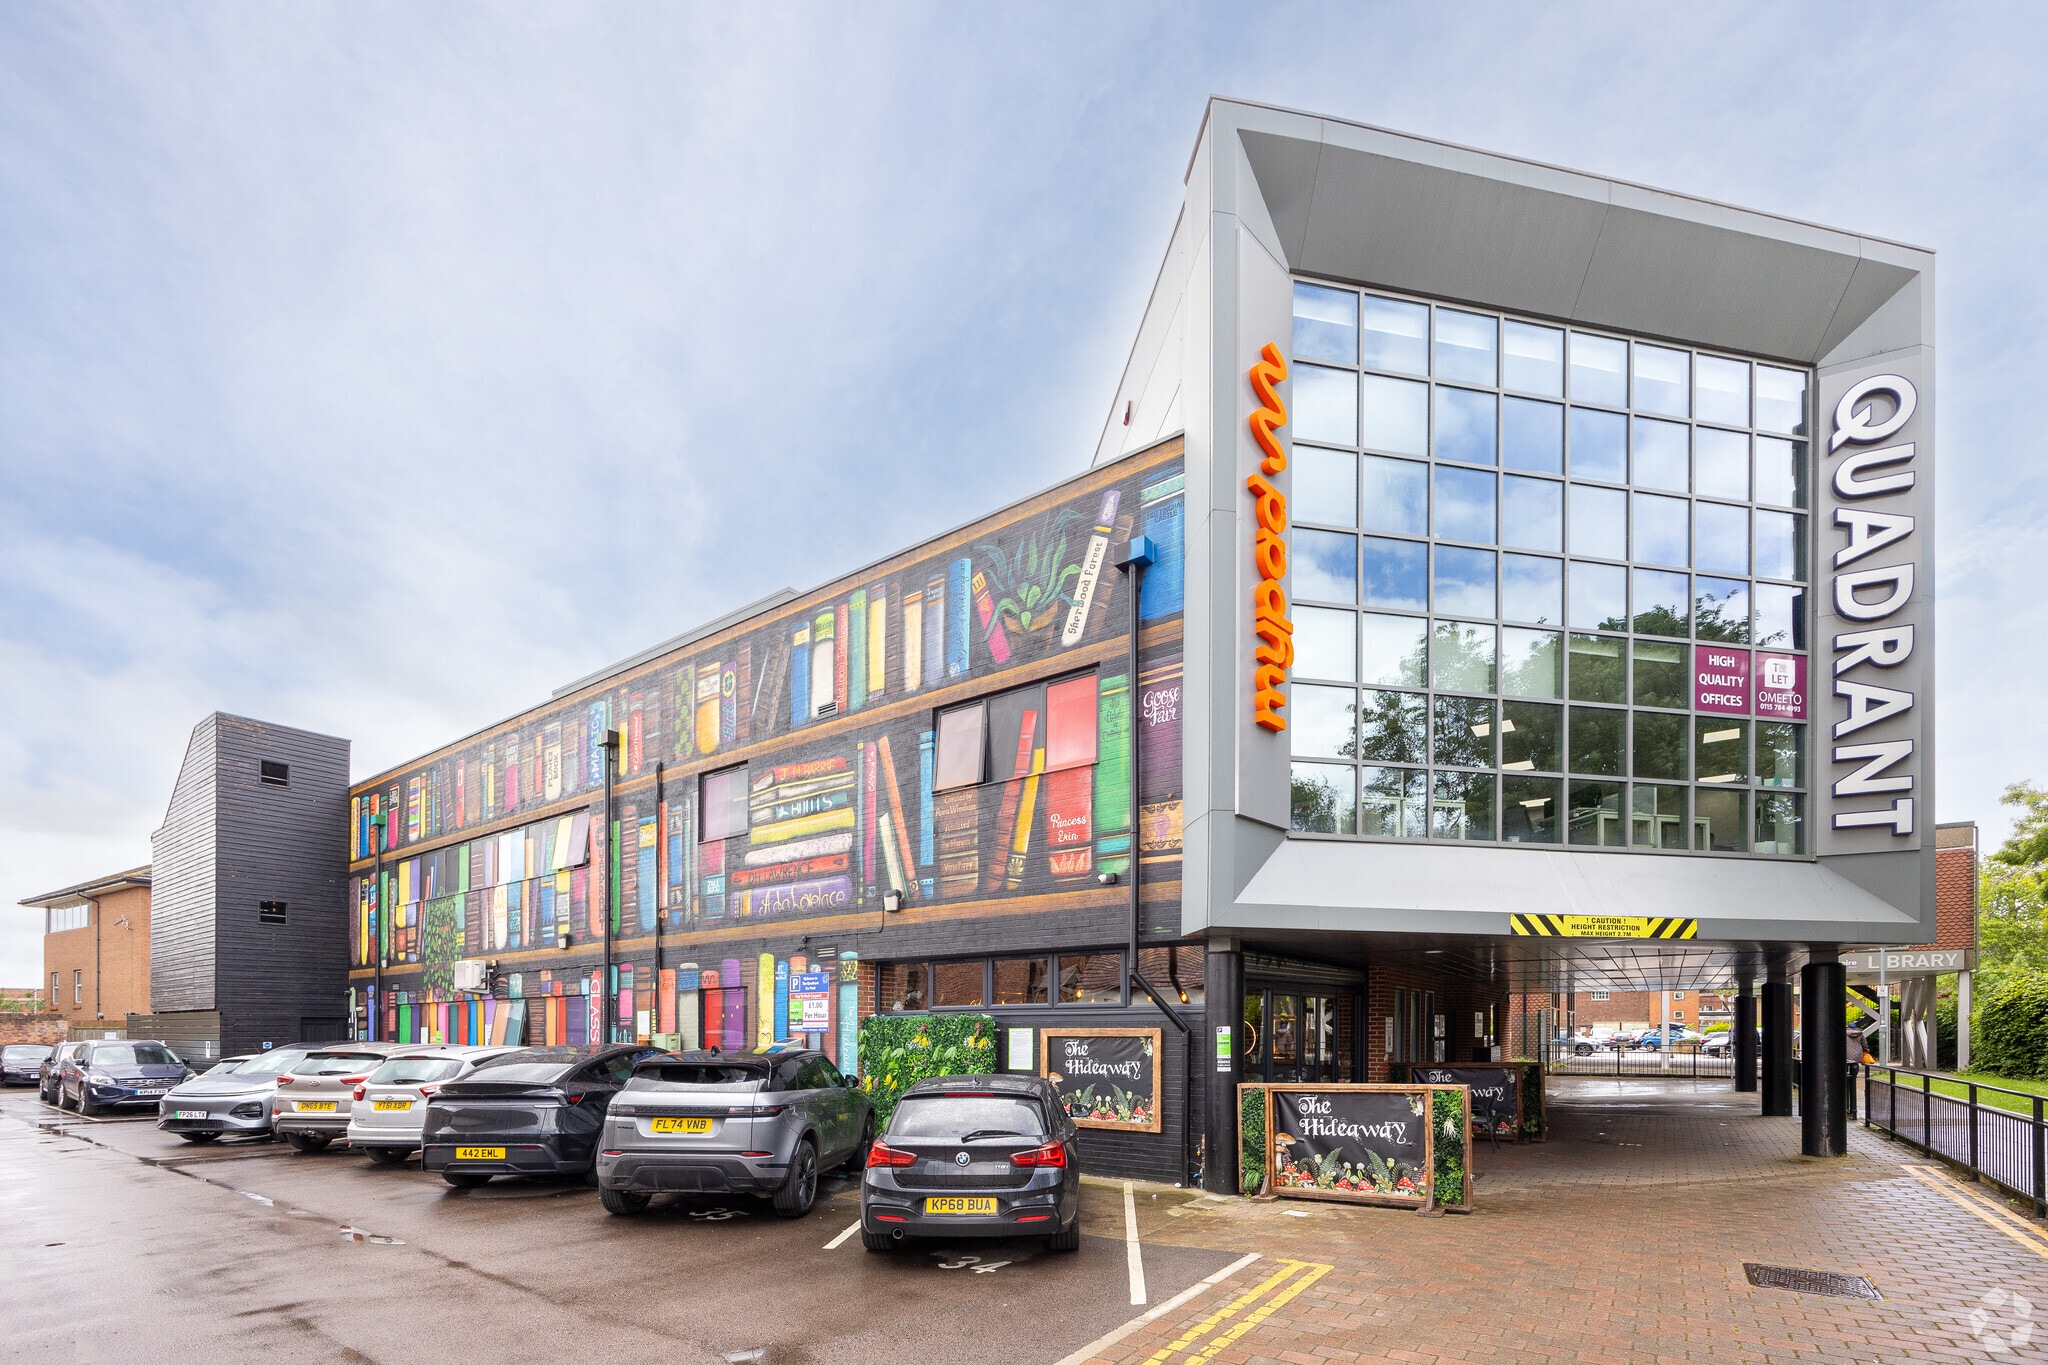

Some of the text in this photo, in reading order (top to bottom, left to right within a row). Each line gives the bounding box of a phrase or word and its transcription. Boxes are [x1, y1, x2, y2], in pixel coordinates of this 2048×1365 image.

[1154, 510, 1178, 523] CASTLE
[1067, 541, 1103, 635] Sherwood Forest
[1247, 472, 1295, 733] mypad
[1829, 372, 1919, 836] QUADRANT
[1708, 654, 1735, 668] HIGH
[837, 661, 846, 704] National
[1698, 673, 1744, 688] QUALITY
[1771, 674, 1788, 685] LET
[1143, 687, 1180, 717] Goose
[1700, 692, 1742, 706] OFFICES
[1758, 691, 1802, 705] OMEETO
[722, 701, 735, 742] Birds
[1149, 706, 1177, 726] Fair
[590, 713, 601, 772] MAGIC
[779, 768, 788, 781] J
[792, 767, 800, 777] M
[1050, 813, 1087, 829] Princess
[1058, 830, 1079, 843] Erin
[748, 861, 814, 884] DH LAWRENCE
[1571, 923, 1640, 932] HEIGHT RESTRICTION
[1591, 917, 1621, 925] CAUTION
[1868, 953, 1959, 969] LBRARY
[590, 979, 600, 1042] GLASS
[813, 1011, 827, 1019] Hour
[841, 1016, 857, 1077] Hideaw
[1064, 1039, 1089, 1057] The
[1064, 1059, 1142, 1080] Hideaway
[1428, 1069, 1453, 1083] The
[1298, 1094, 1332, 1115] The
[655, 1119, 707, 1130] FL74 VNB
[1299, 1118, 1408, 1144] Hideaway
[462, 1149, 499, 1158] 442 EML
[931, 1199, 991, 1211] KP68 BUA
